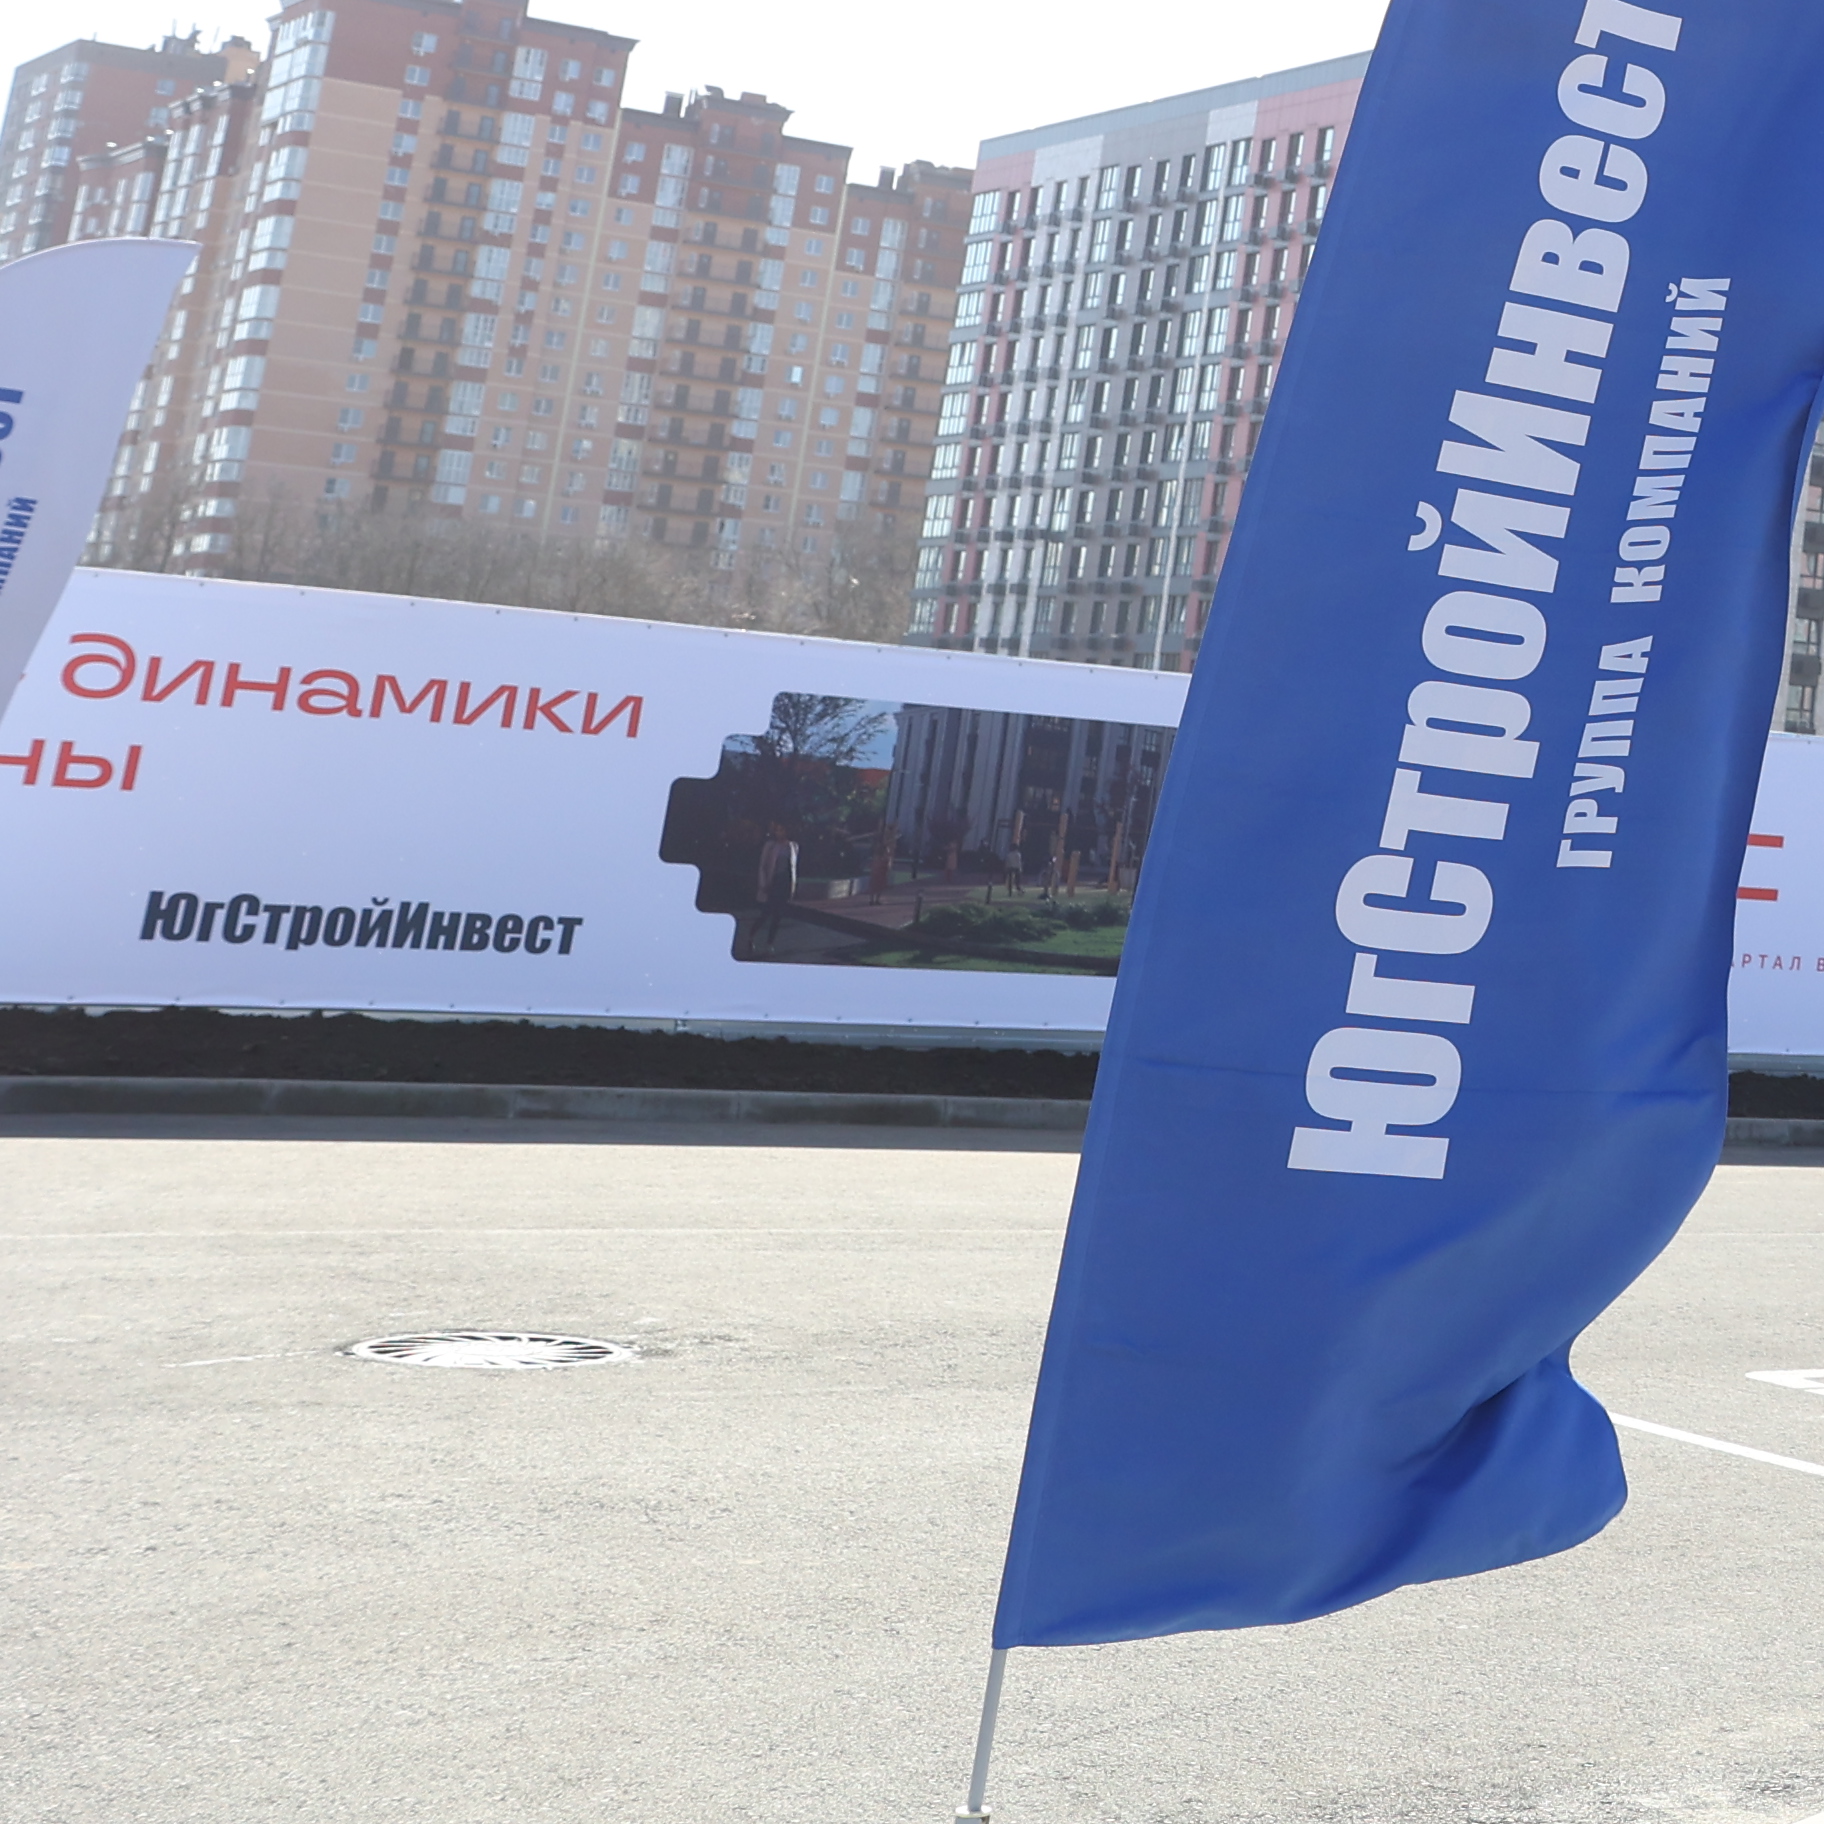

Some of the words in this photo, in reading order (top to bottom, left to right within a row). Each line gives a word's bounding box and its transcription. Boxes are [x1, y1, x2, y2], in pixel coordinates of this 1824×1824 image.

[1556, 635, 1653, 868] ГРУППА
[1610, 277, 1731, 603] КОМПАНИЙ
[59, 632, 644, 739] динамики
[139, 891, 584, 955] ЮгСтройИнвест
[1731, 953, 1802, 971] РТАЛ
